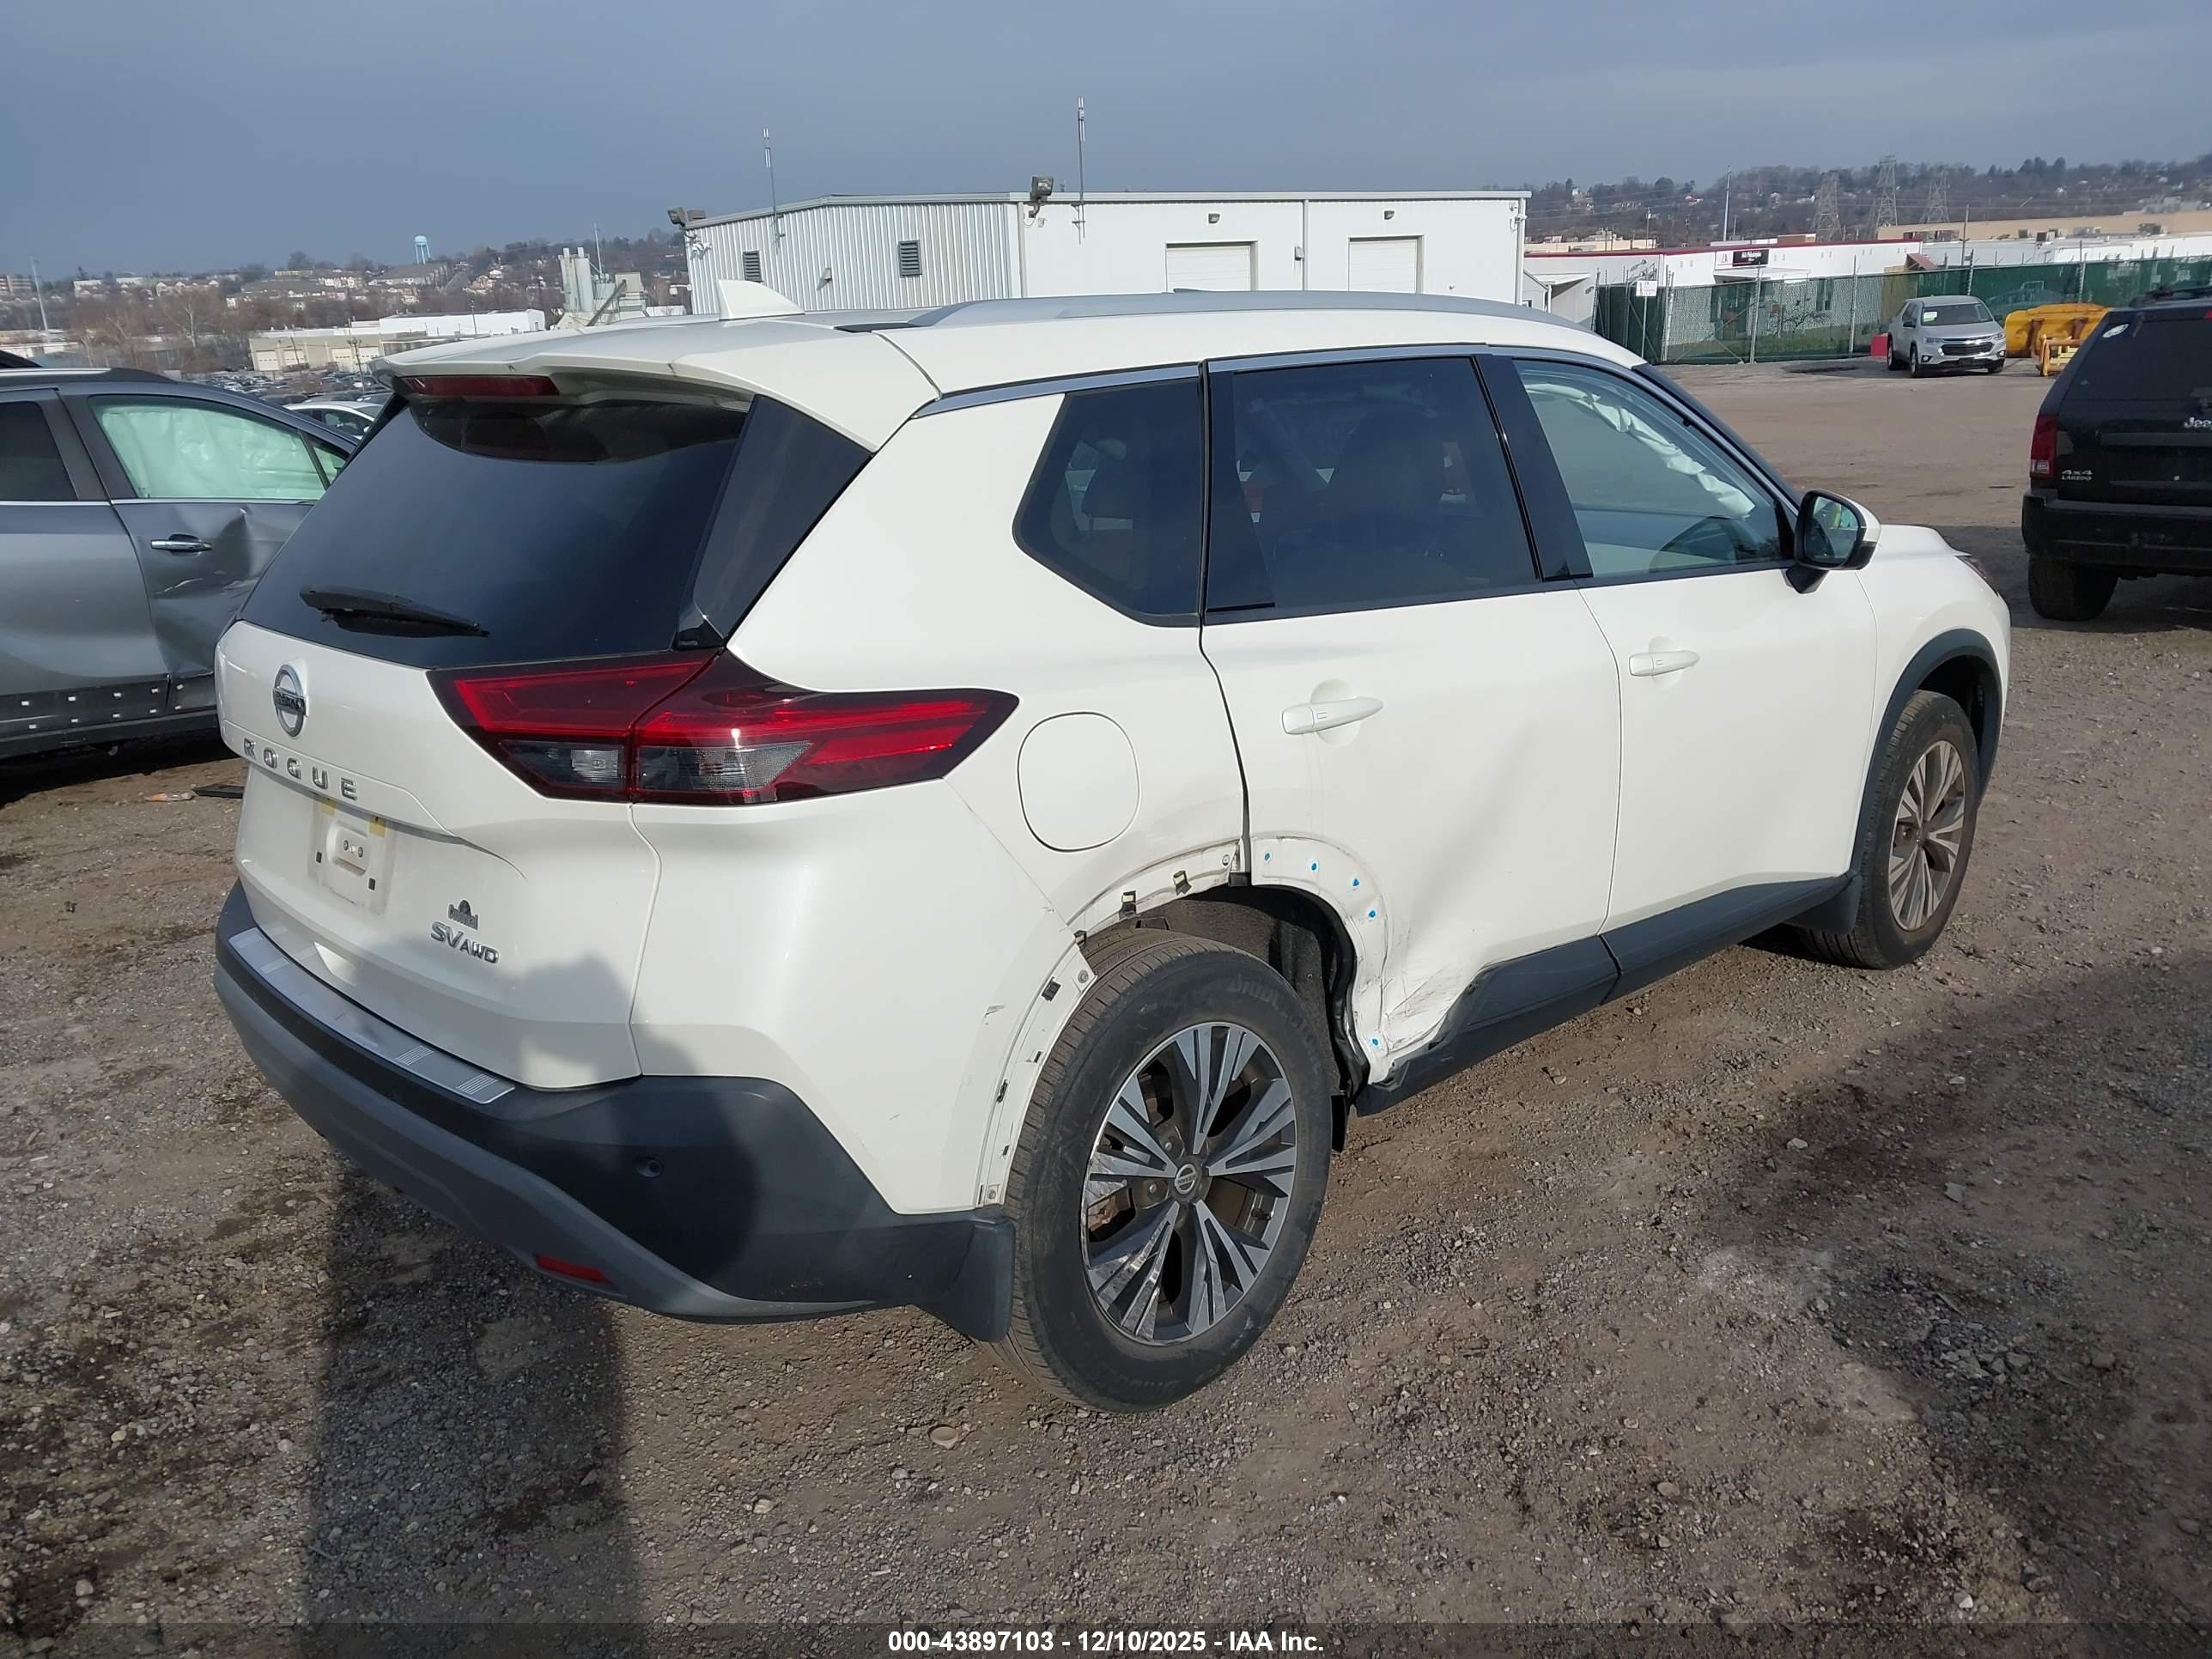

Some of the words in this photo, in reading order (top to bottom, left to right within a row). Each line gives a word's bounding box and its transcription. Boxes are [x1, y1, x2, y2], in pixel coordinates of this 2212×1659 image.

[2184, 416, 2212, 429] Jee
[244, 737, 358, 801] ROGUE
[430, 921, 464, 949] SV
[459, 939, 501, 964] AWD
